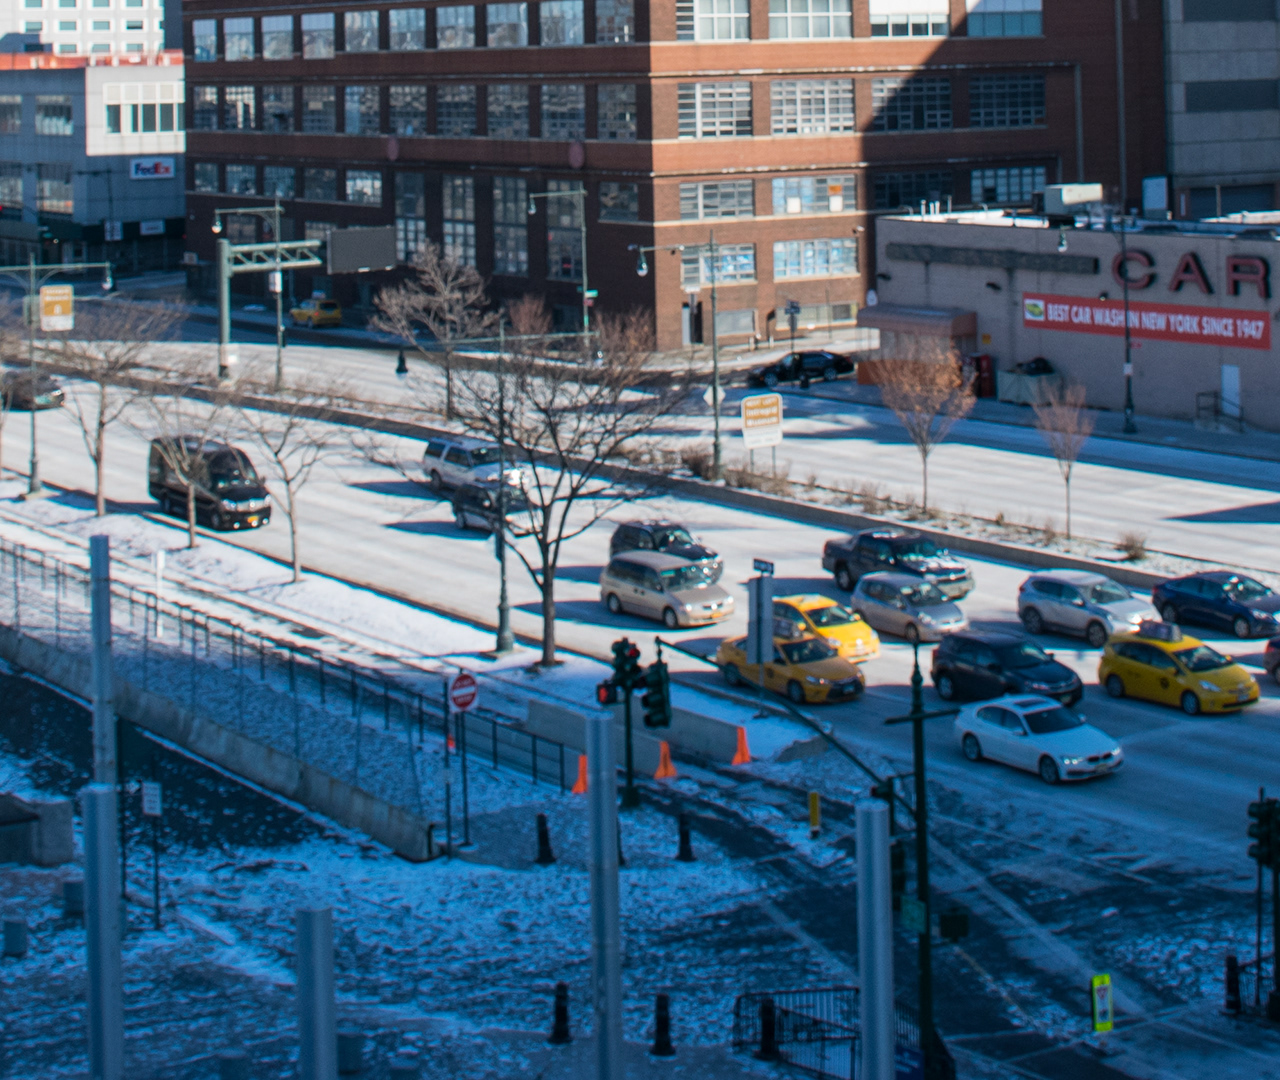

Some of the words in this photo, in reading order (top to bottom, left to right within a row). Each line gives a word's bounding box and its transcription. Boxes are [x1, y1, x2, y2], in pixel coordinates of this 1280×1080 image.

[134, 162, 172, 176] FedEx
[1111, 248, 1273, 300] CAR
[1047, 303, 1070, 322] BEST
[1071, 305, 1091, 324] CAR
[1092, 308, 1125, 327] WASH
[1141, 311, 1167, 332] NEW
[1168, 313, 1200, 334] YORK
[1201, 315, 1235, 338] SINCE
[1236, 318, 1265, 340] 1947
